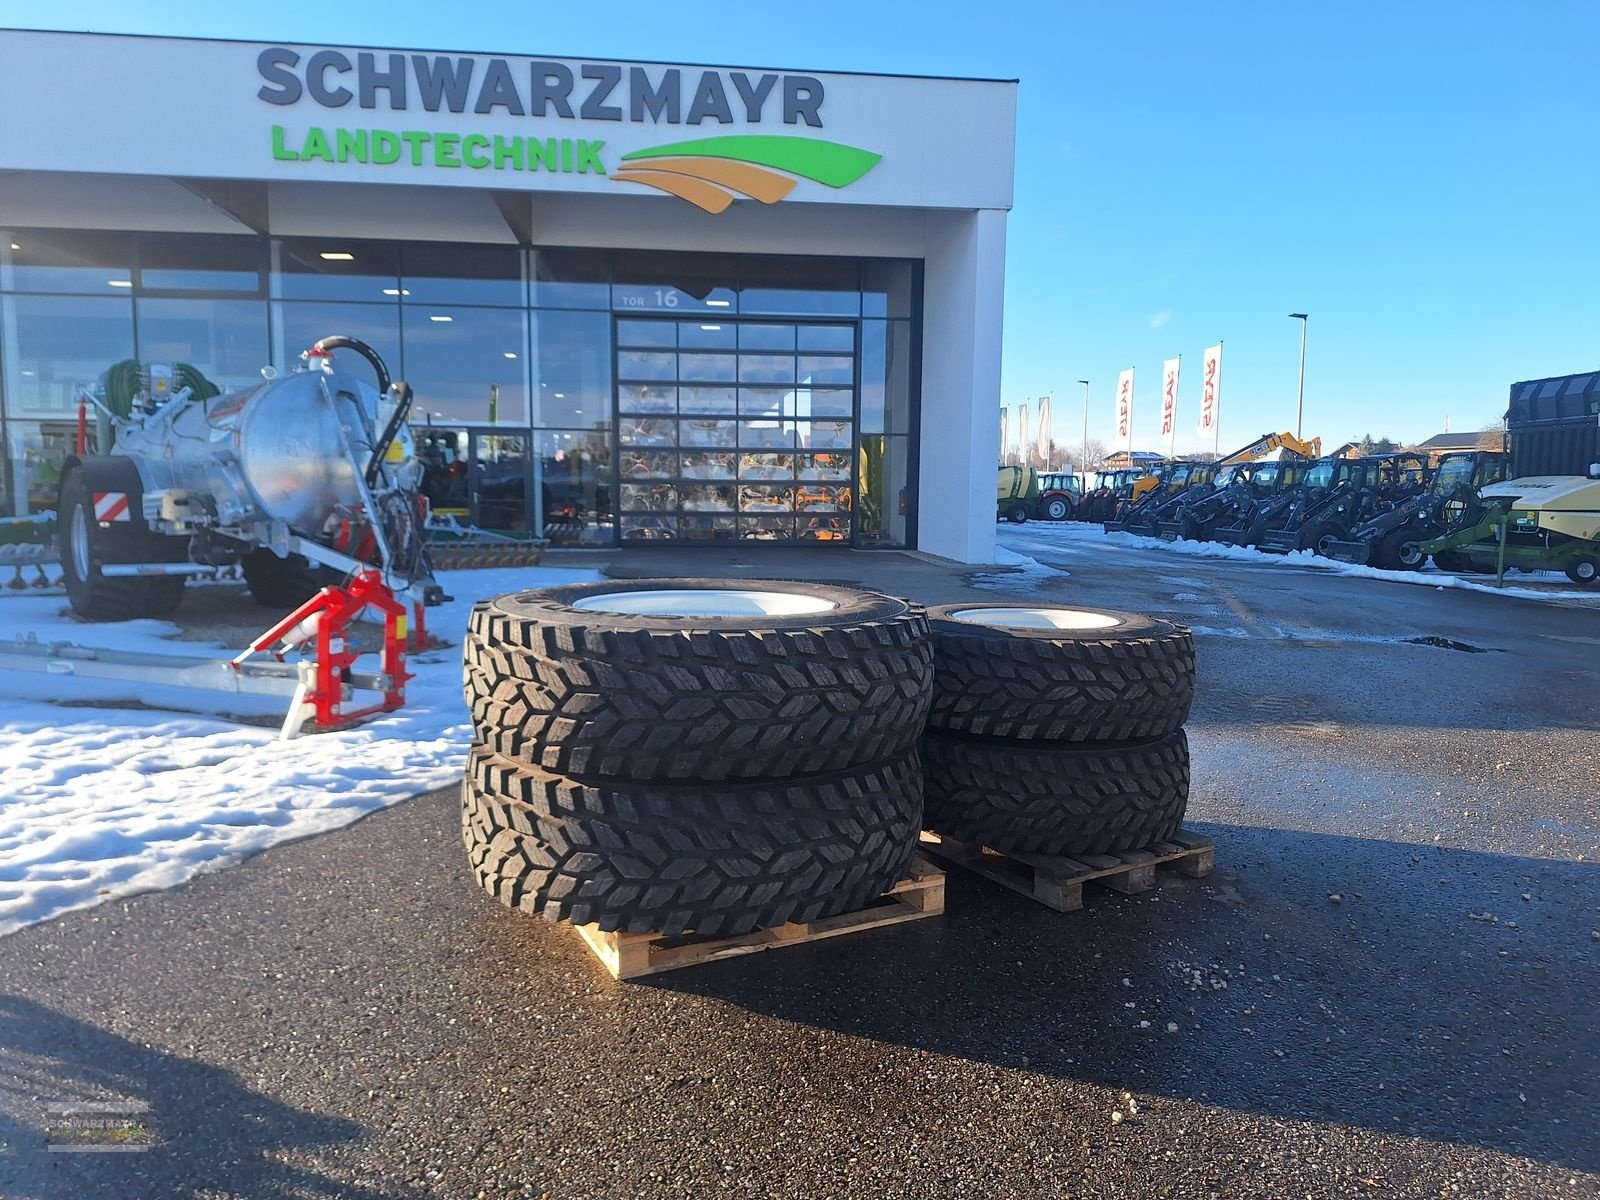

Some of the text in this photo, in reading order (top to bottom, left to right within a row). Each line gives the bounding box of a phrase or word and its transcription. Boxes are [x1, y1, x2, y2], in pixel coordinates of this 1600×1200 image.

[257, 47, 825, 128] SCHWARZMAYR
[271, 125, 607, 175] LANDTECHNIK
[622, 290, 678, 307] TOR 16
